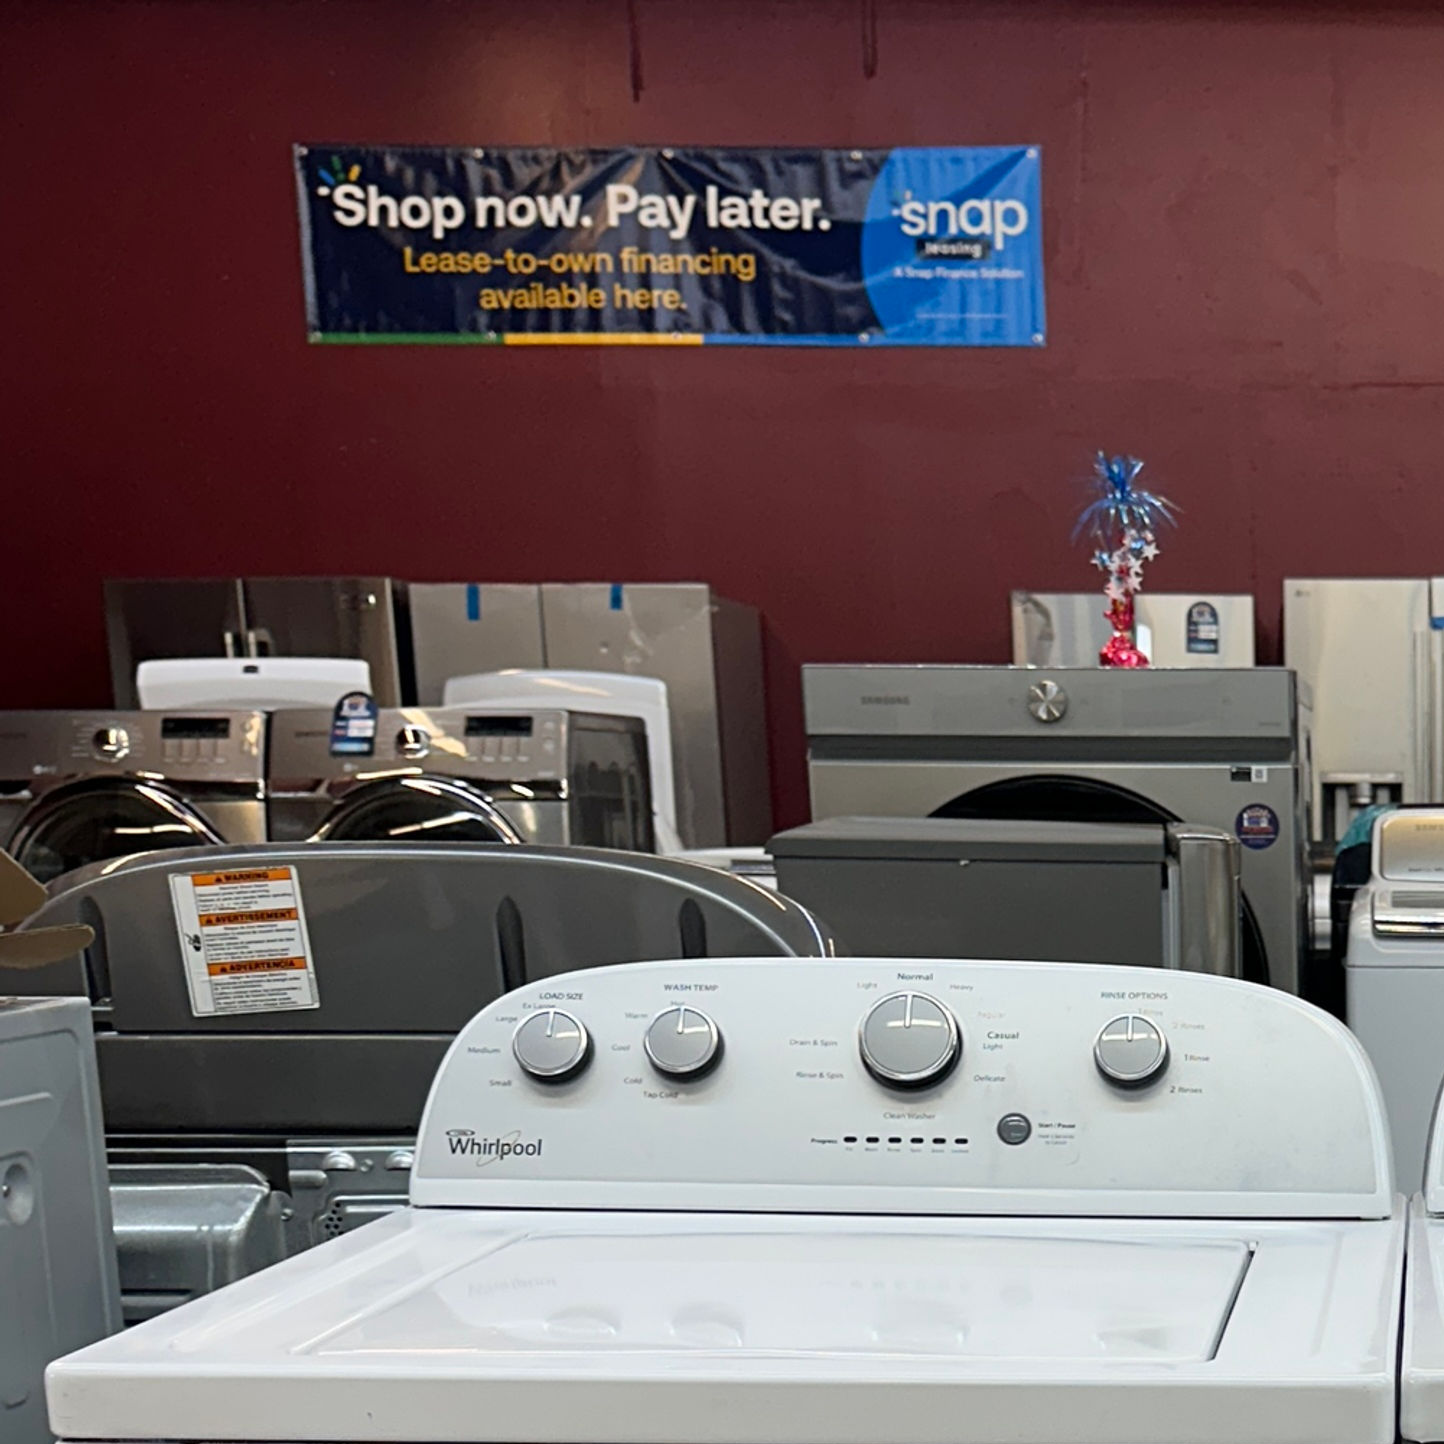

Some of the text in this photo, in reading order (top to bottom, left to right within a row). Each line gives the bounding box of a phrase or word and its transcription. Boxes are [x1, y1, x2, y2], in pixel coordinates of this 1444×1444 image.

[332, 183, 832, 240] Shop now. Pay later.
[900, 198, 1029, 250] snap
[924, 241, 983, 259] leasing
[403, 246, 756, 282] Lease-to-own financing
[479, 282, 688, 310] available here.
[223, 871, 270, 882] WARNING
[215, 911, 293, 923] AVERTISSEMENT
[897, 972, 934, 981] Normal
[663, 984, 692, 992] WASH
[539, 992, 564, 1000] LOAD
[1100, 992, 1169, 1000] RINSE OPTIONS
[987, 1030, 1020, 1040] Casual
[448, 1137, 543, 1160] Whirlpool
